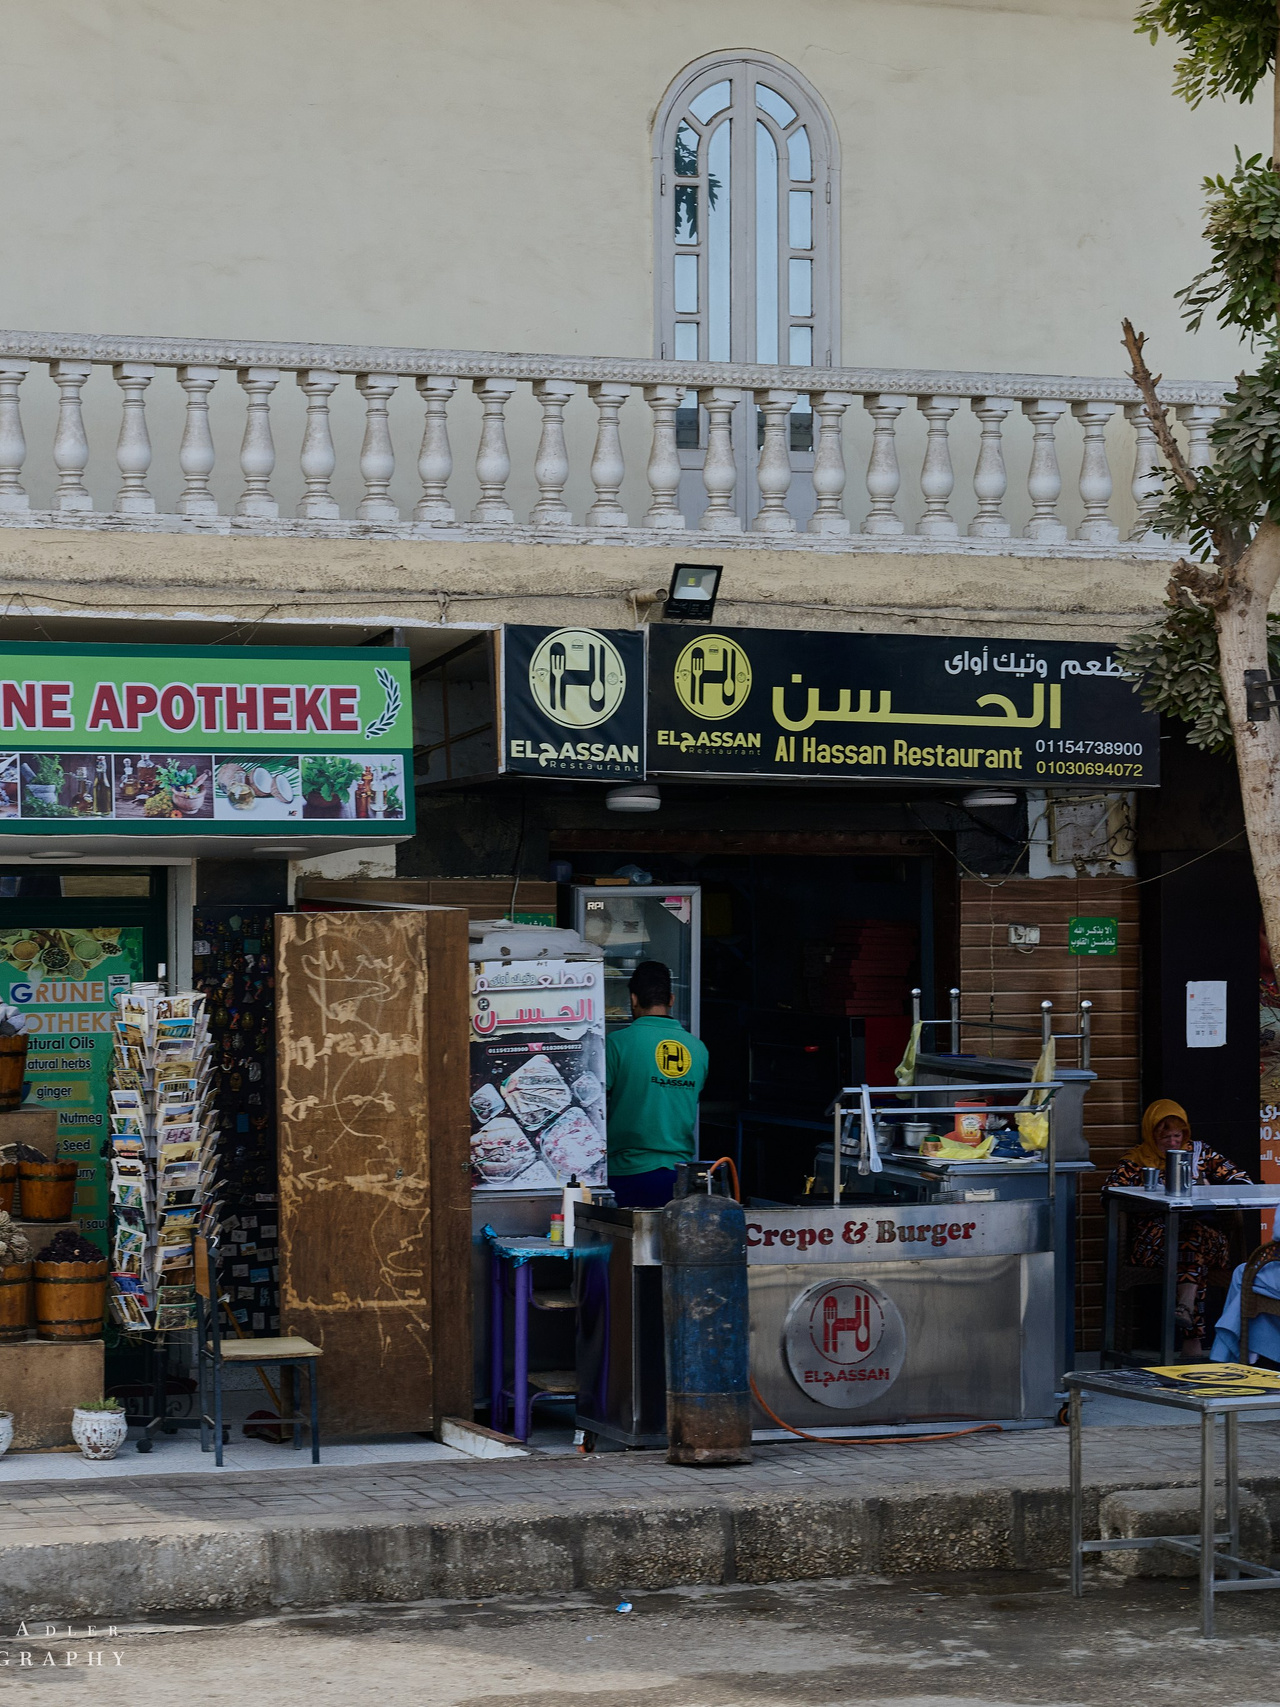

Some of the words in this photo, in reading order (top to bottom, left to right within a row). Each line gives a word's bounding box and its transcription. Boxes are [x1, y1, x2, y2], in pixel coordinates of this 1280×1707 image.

[993, 652, 1048, 678] وتيك
[88, 683, 360, 731] APOTHEKE
[771, 673, 1061, 731] الحسن
[688, 747, 761, 756] Restaurant
[775, 737, 801, 764] Al
[803, 736, 887, 767] Hassan
[892, 740, 1023, 769] Restaurant
[1035, 739, 1143, 756] 01154738900
[550, 760, 639, 772] Restaurant
[1036, 759, 1143, 777] 01030694072
[11, 977, 104, 1003] GRÜNE
[472, 969, 595, 995] مطعم
[472, 997, 594, 1035] الحسن
[27, 1037, 65, 1050] atural
[69, 1037, 95, 1050] Oils
[61, 1058, 91, 1069] herbs
[36, 1085, 73, 1101] ginger
[60, 1112, 103, 1126] Nutmeg
[63, 1139, 91, 1151] Seed
[76, 1168, 96, 1180] urry
[746, 1223, 834, 1251] Crepe
[842, 1220, 868, 1244] &
[876, 1220, 976, 1247] Burger
